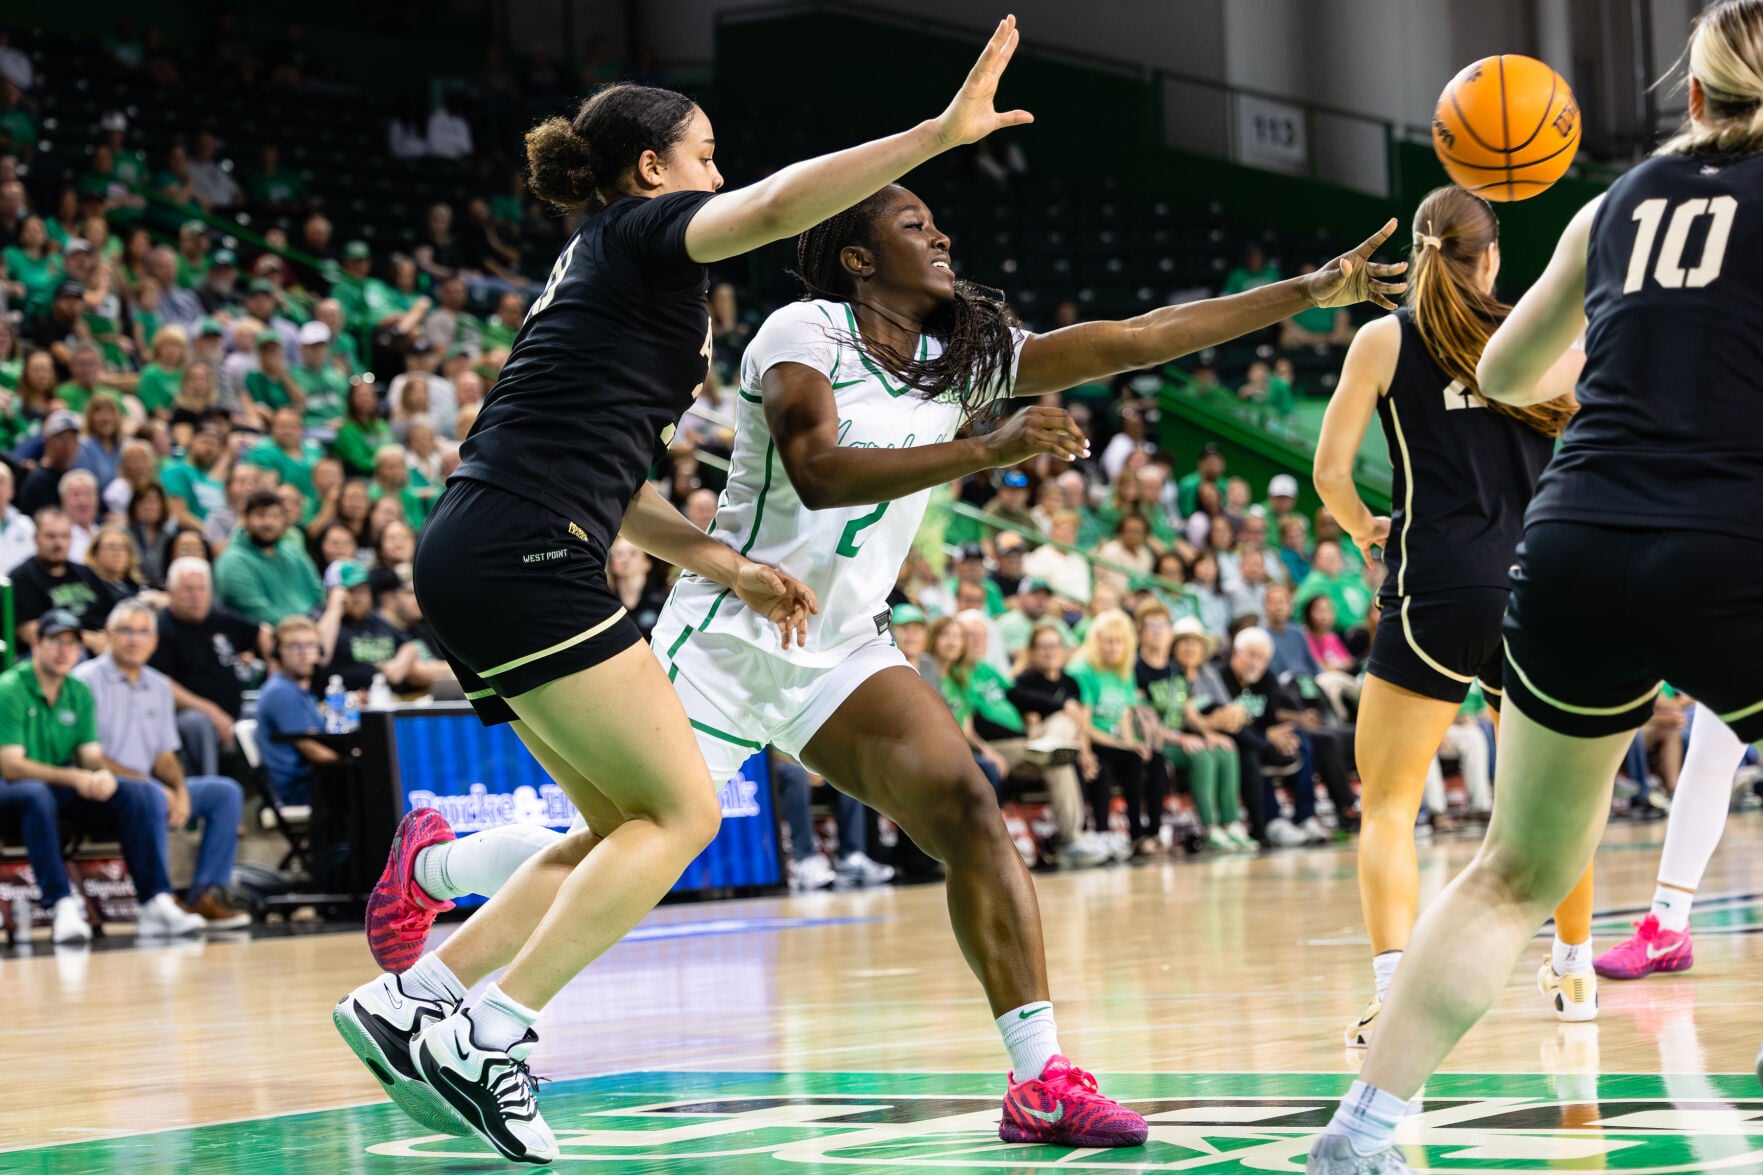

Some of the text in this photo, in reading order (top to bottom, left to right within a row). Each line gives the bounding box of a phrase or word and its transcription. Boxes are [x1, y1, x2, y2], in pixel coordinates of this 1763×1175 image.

[1623, 195, 1738, 295] 10
[522, 548, 568, 563] WEST POINT
[835, 501, 890, 558] 2
